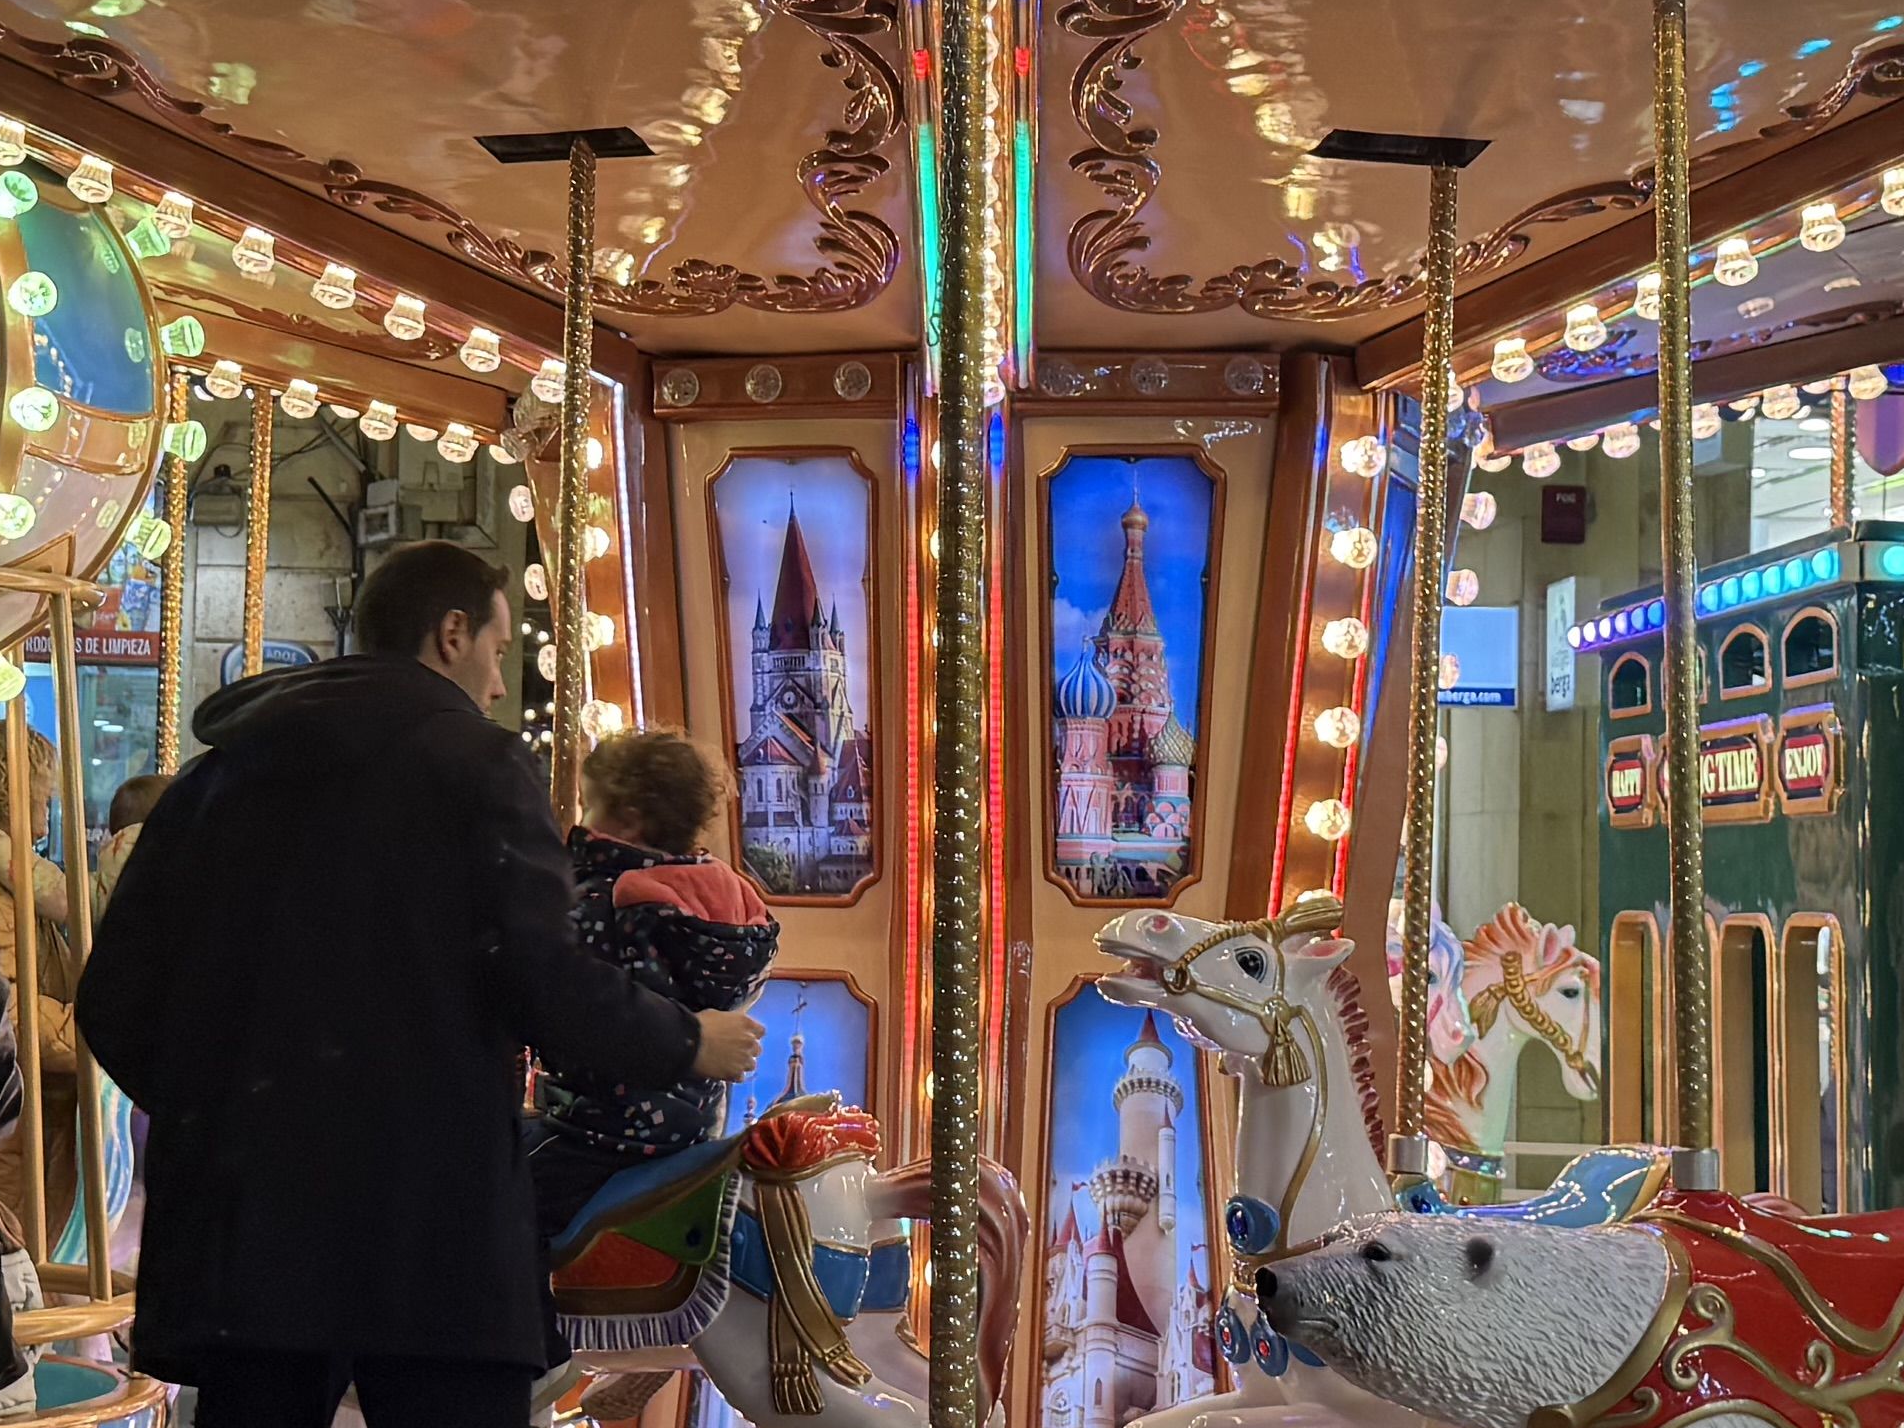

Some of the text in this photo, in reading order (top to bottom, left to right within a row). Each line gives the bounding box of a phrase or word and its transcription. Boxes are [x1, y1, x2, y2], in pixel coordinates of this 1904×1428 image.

[85, 637, 99, 655] DE
[102, 638, 151, 656] LIMPIEZA
[1784, 743, 1825, 780] ENJOY
